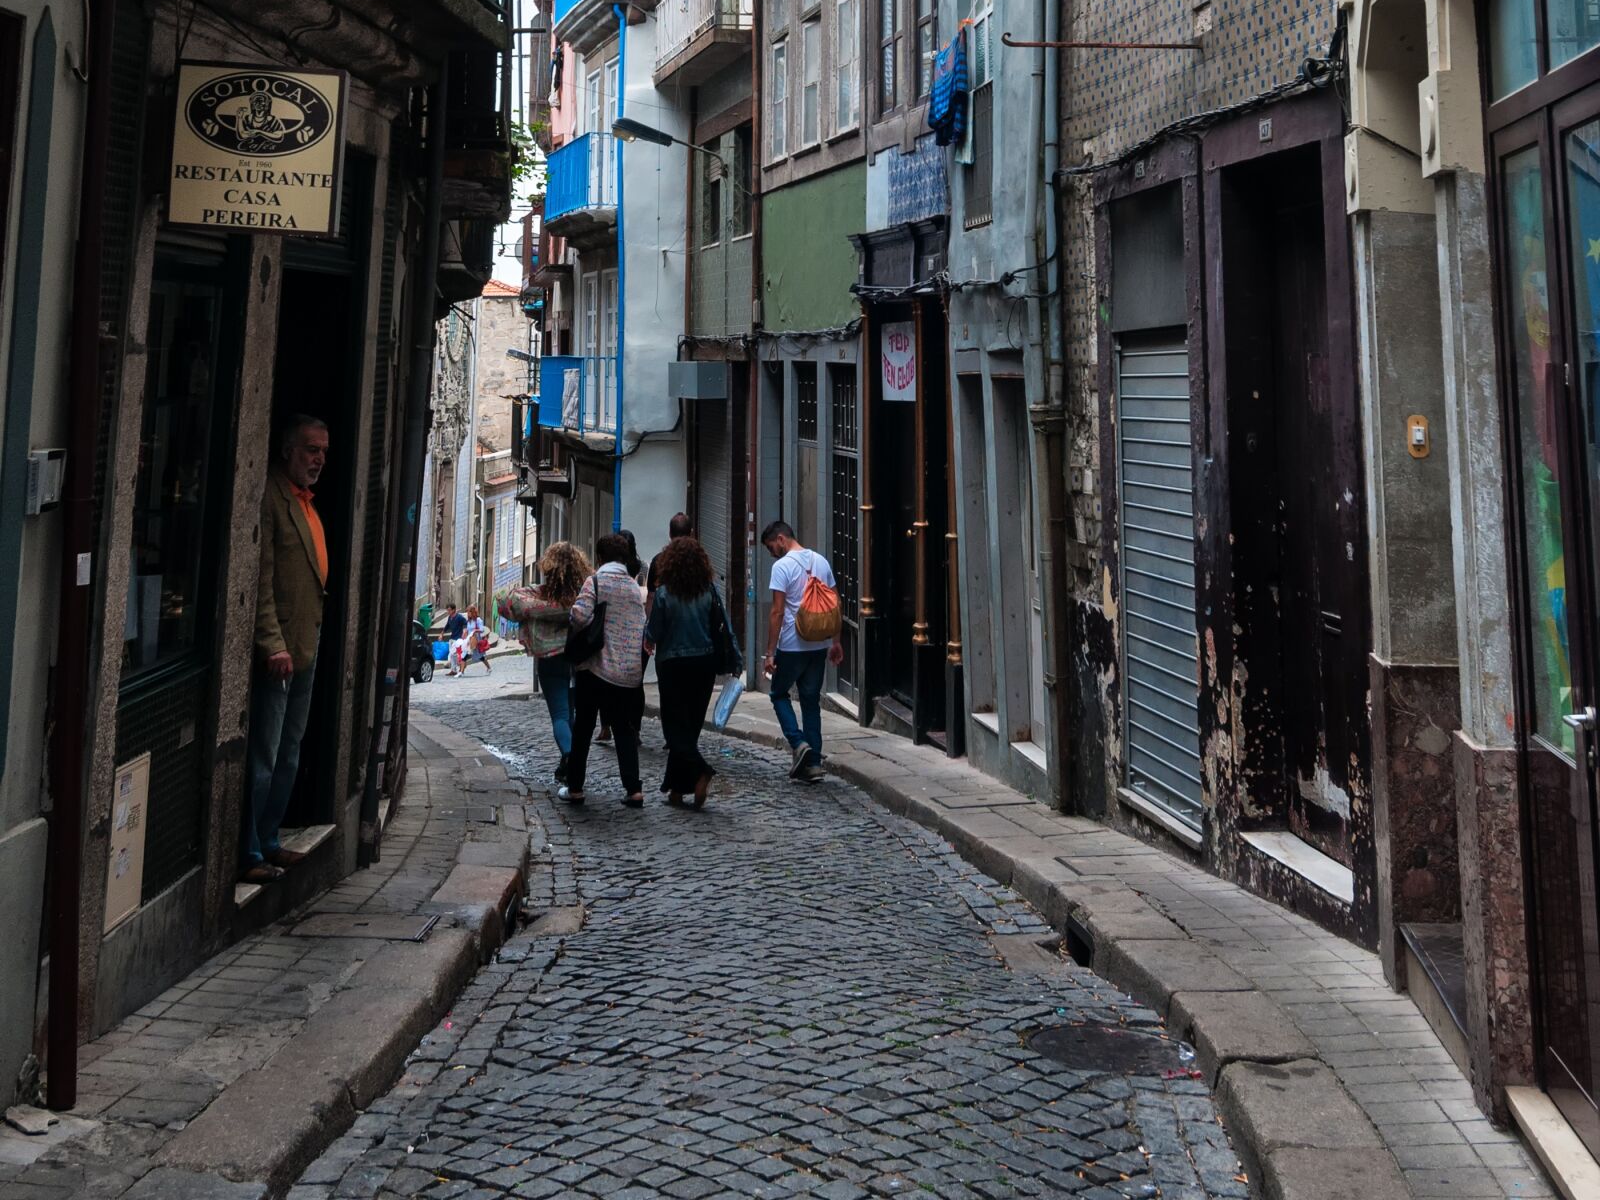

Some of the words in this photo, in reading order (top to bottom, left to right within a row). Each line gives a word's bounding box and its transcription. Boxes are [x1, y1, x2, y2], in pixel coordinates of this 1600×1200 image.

[201, 78, 318, 114] SOTOCAL
[174, 164, 332, 189] RESTAURANTE
[223, 189, 281, 206] CASA
[202, 209, 298, 229] PEREIRA
[888, 332, 910, 353] TOP
